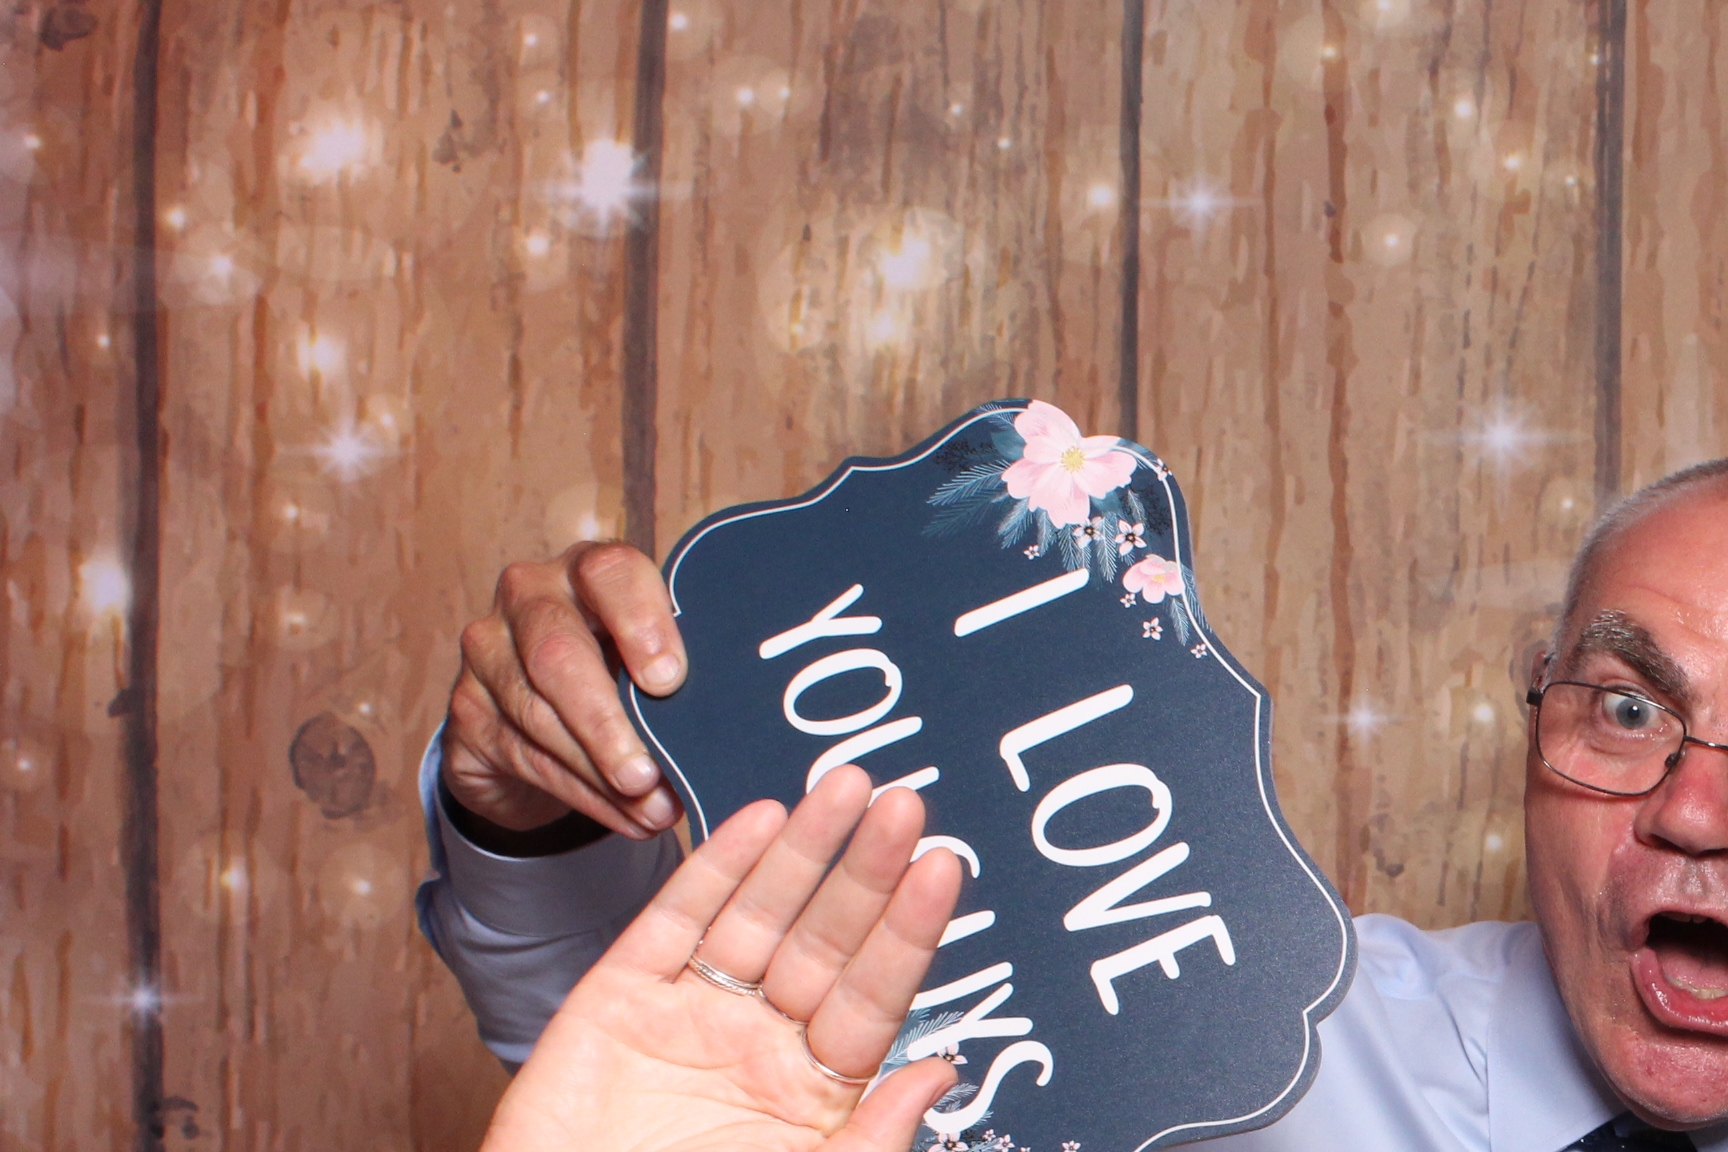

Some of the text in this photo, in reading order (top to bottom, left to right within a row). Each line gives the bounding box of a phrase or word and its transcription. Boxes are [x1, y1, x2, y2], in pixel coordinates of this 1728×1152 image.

[759, 584, 1054, 1134] YOU UYS
[954, 568, 1236, 1014] I LOVE
